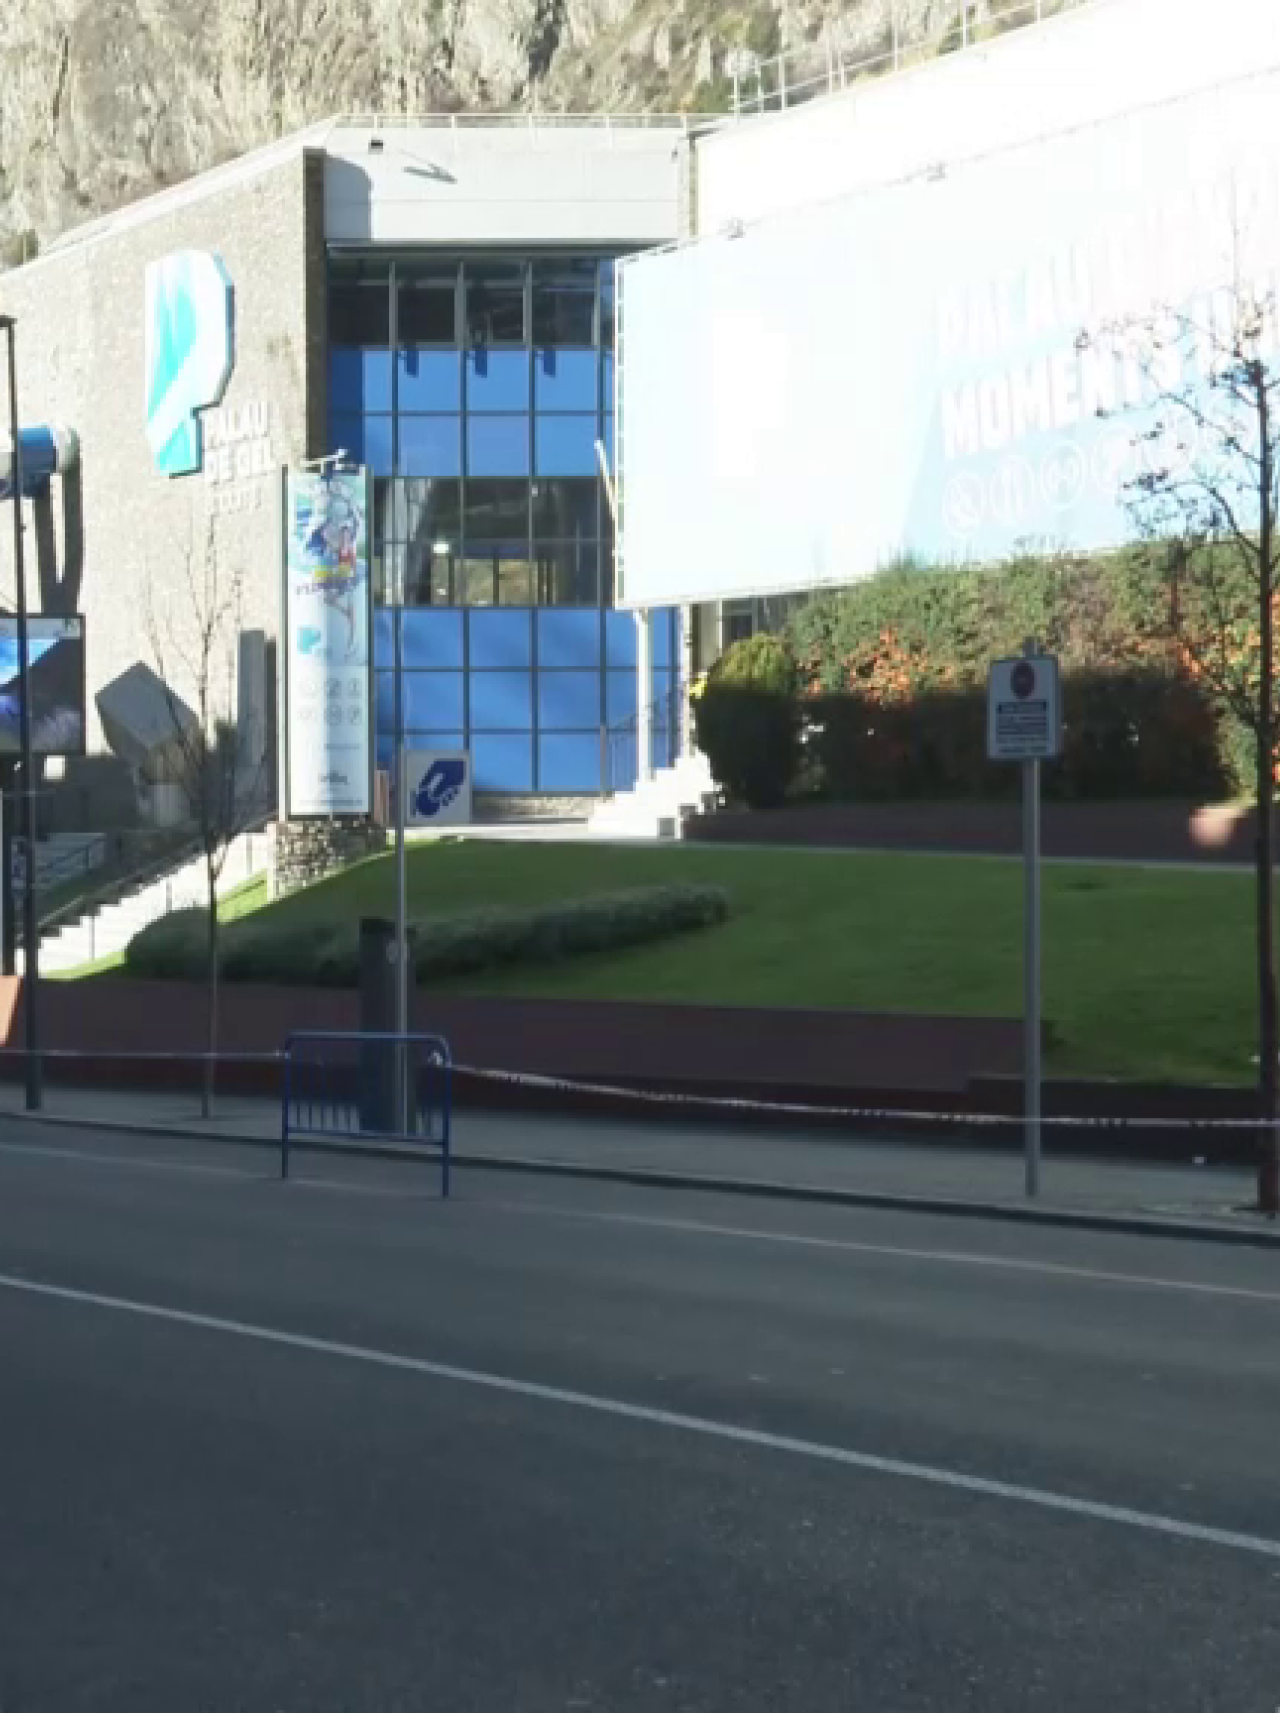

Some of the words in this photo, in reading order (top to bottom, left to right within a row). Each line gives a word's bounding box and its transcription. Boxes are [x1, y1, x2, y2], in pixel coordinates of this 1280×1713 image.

[204, 401, 269, 449] PALAU
[204, 444, 234, 485] DE
[236, 440, 276, 479] GEL
